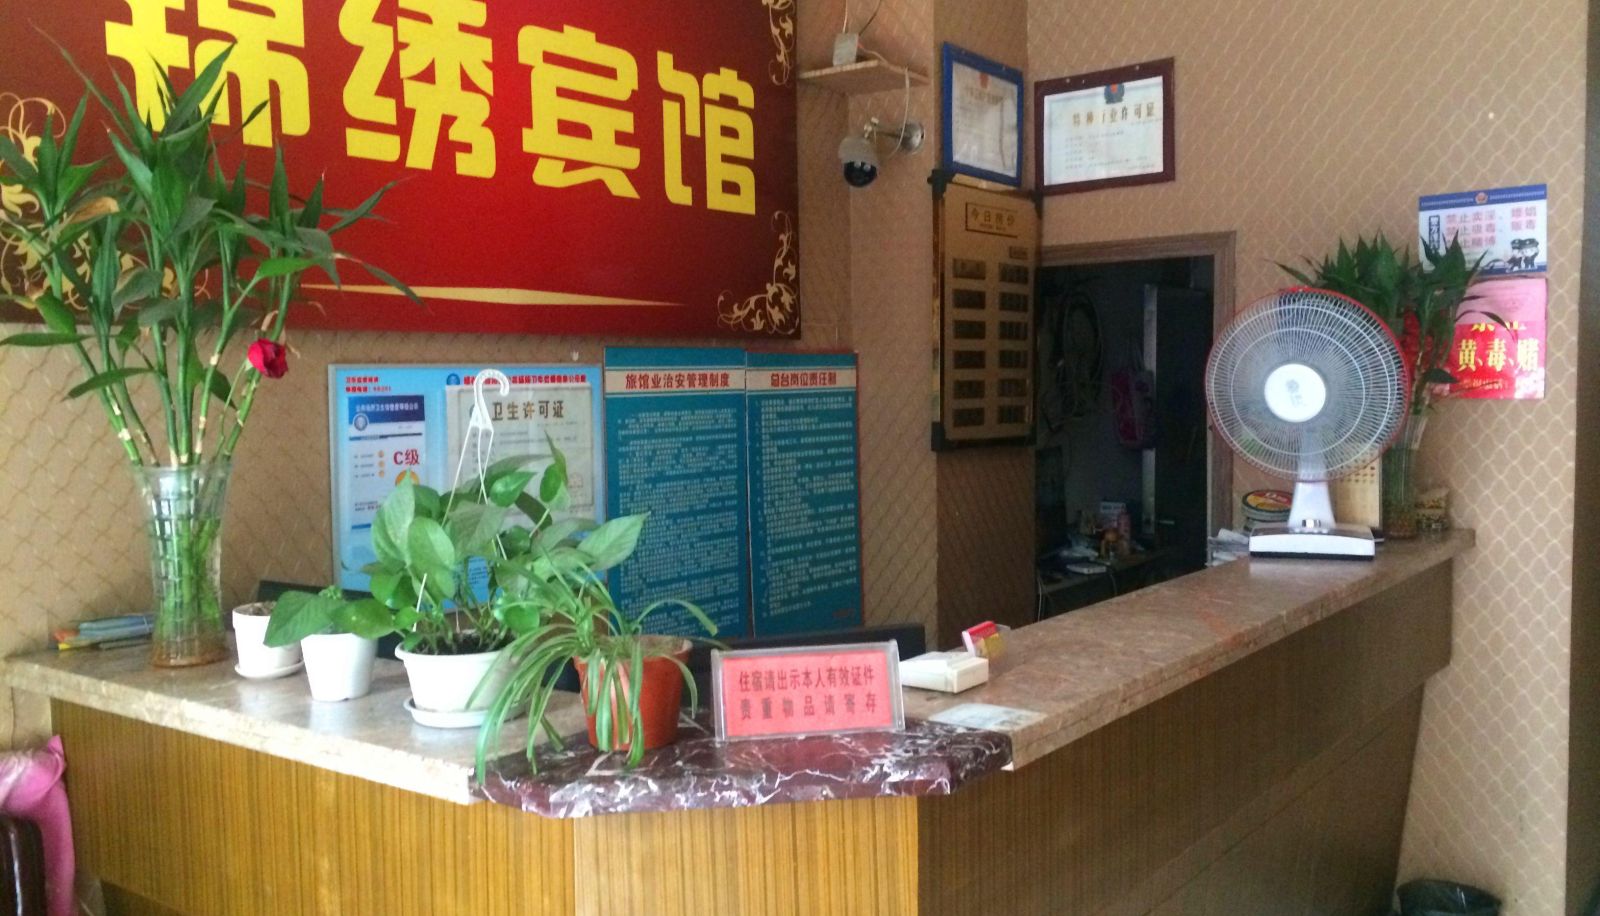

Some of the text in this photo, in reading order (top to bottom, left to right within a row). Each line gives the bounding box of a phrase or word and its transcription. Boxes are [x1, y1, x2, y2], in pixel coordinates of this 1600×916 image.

[625, 373, 731, 389] 旅馆业治安管理制度
[770, 372, 837, 387] 总台岗位责任制
[491, 400, 564, 421] 卫生许可证
[393, 449, 420, 466] C级
[739, 664, 875, 692] 住宿请出示本人有效证件
[740, 691, 877, 721] 贵重物品请寄存
